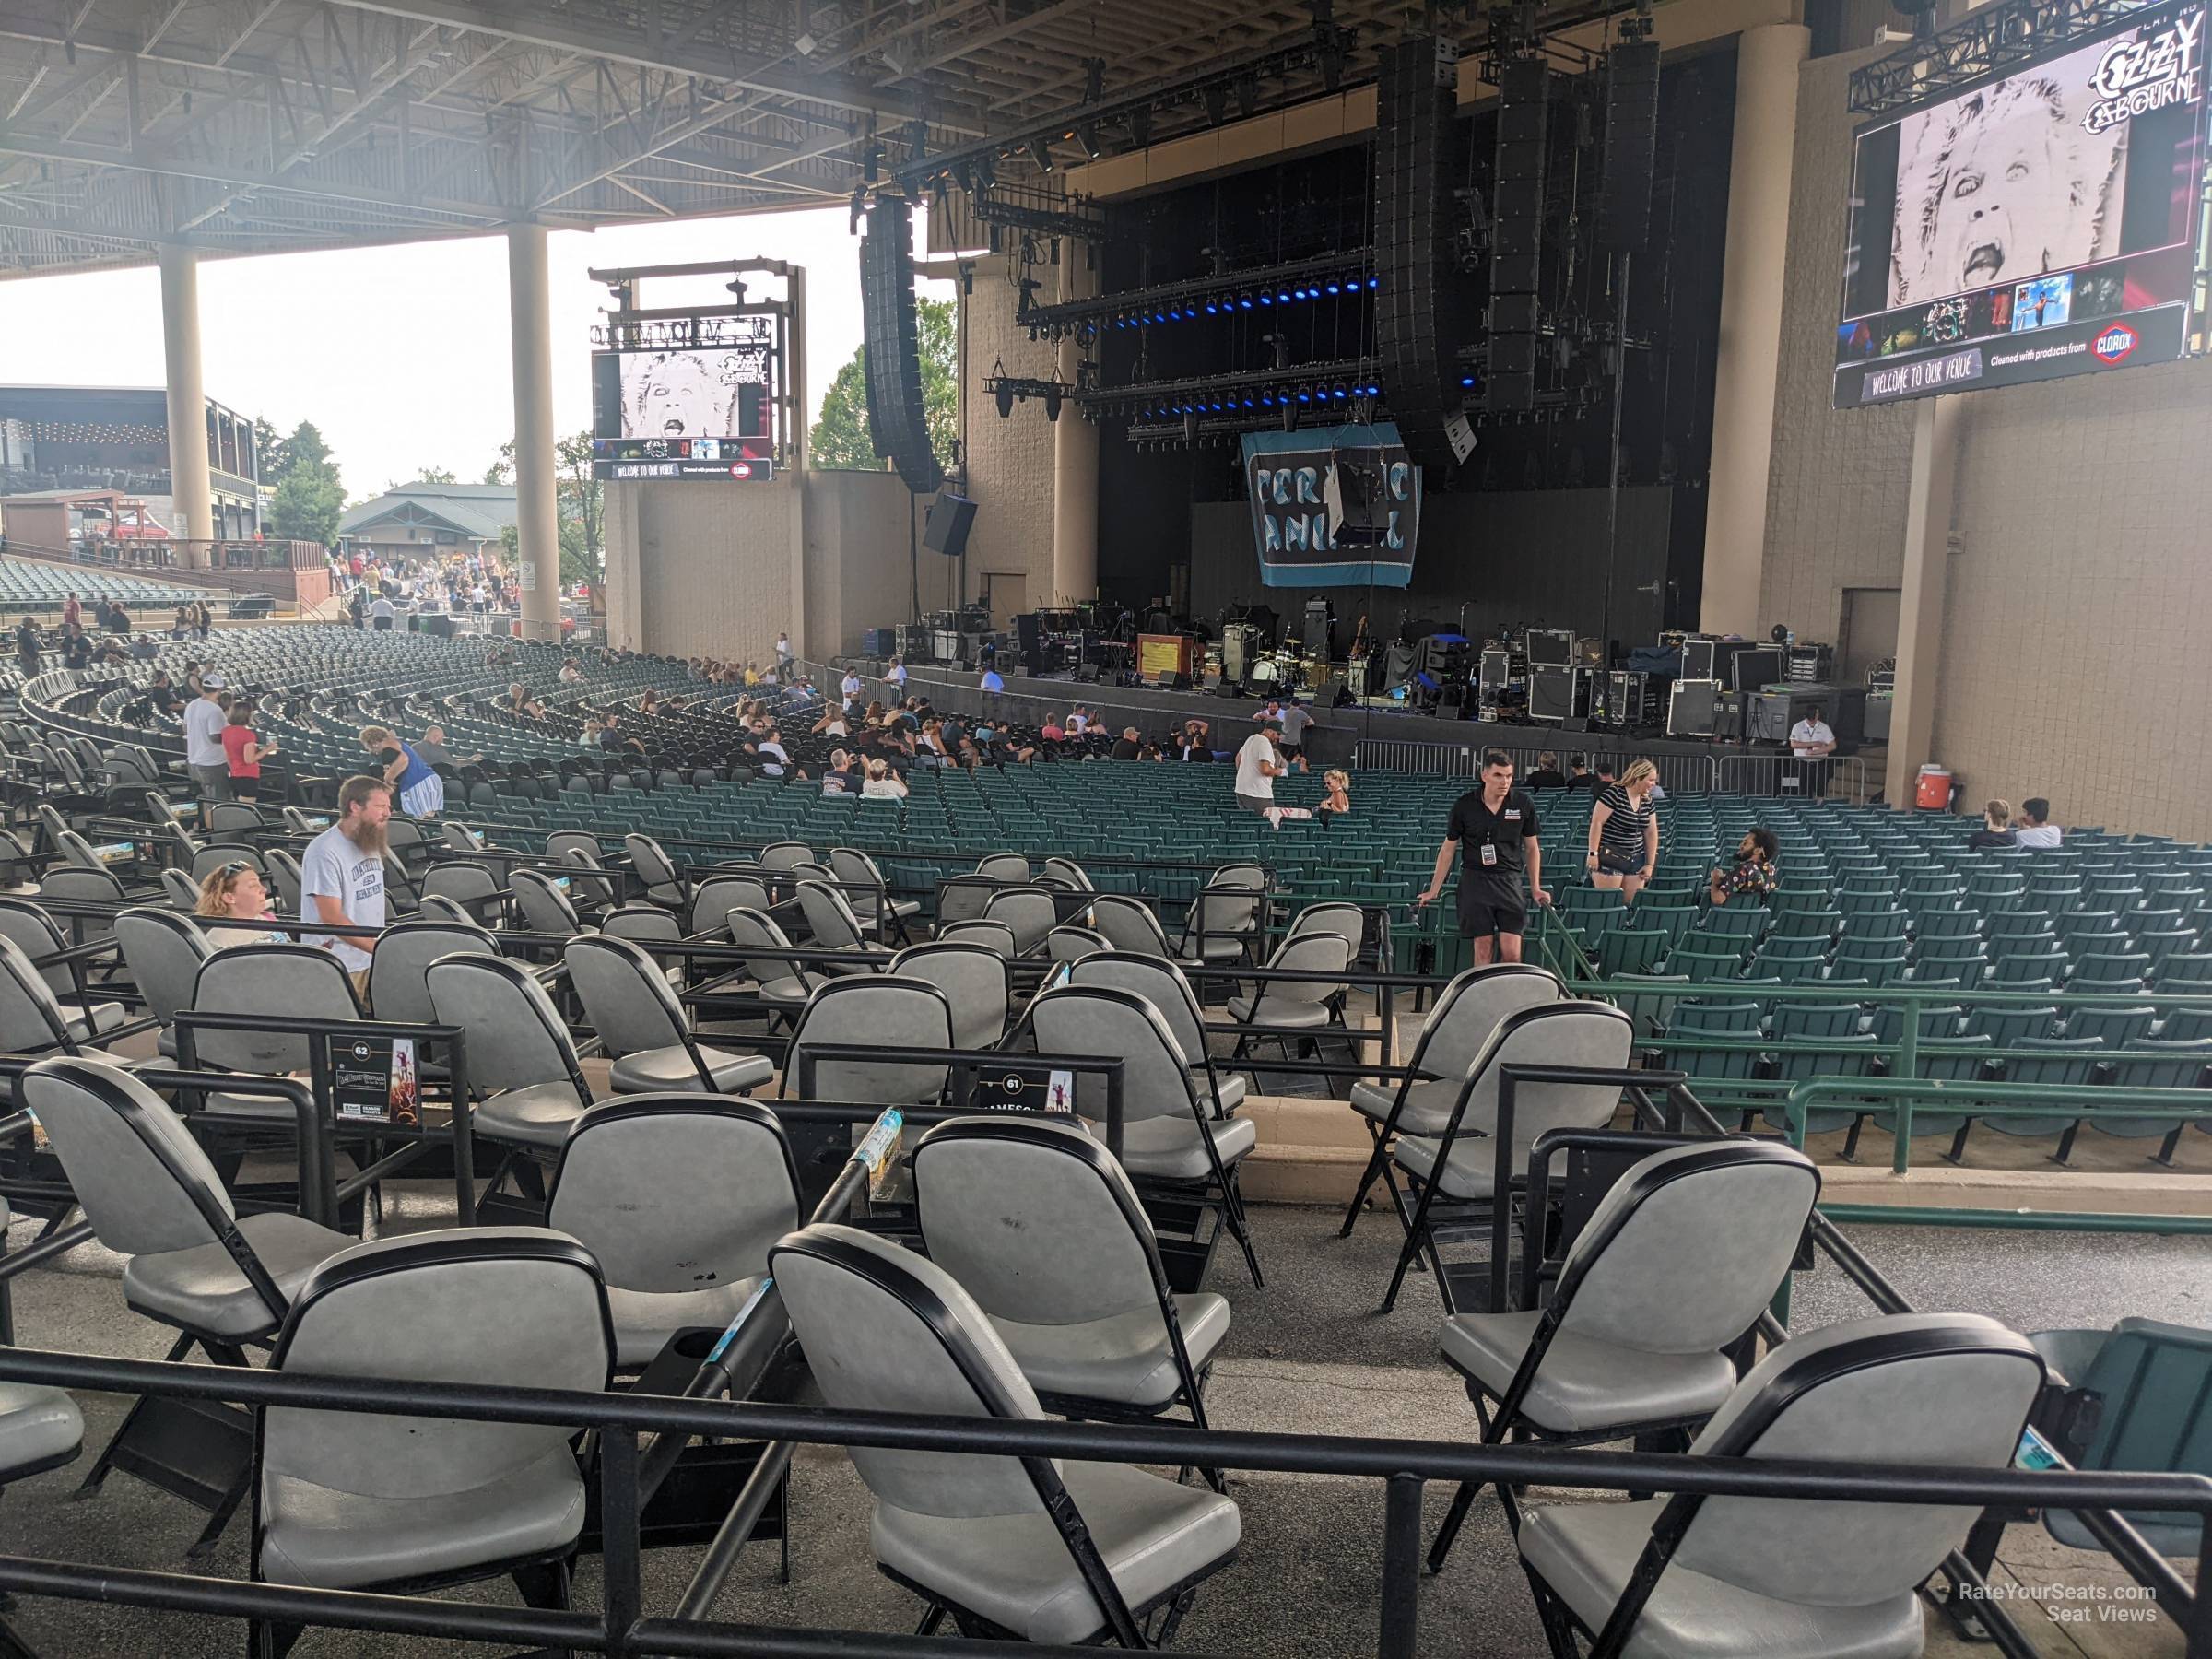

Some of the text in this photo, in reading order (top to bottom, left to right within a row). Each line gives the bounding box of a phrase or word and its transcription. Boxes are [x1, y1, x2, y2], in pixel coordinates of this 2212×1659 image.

[2088, 10, 2204, 100] OZZY
[2080, 65, 2203, 135] OSBOURNE
[1991, 342, 2086, 366] Cleaned with products from
[2097, 333, 2132, 354] CLOROX
[1873, 354, 1971, 395] WELCOME TO OUR VENUE
[1265, 510, 1406, 552] ANIL
[355, 1046, 368, 1055] 62
[1006, 1079, 1019, 1088] 61
